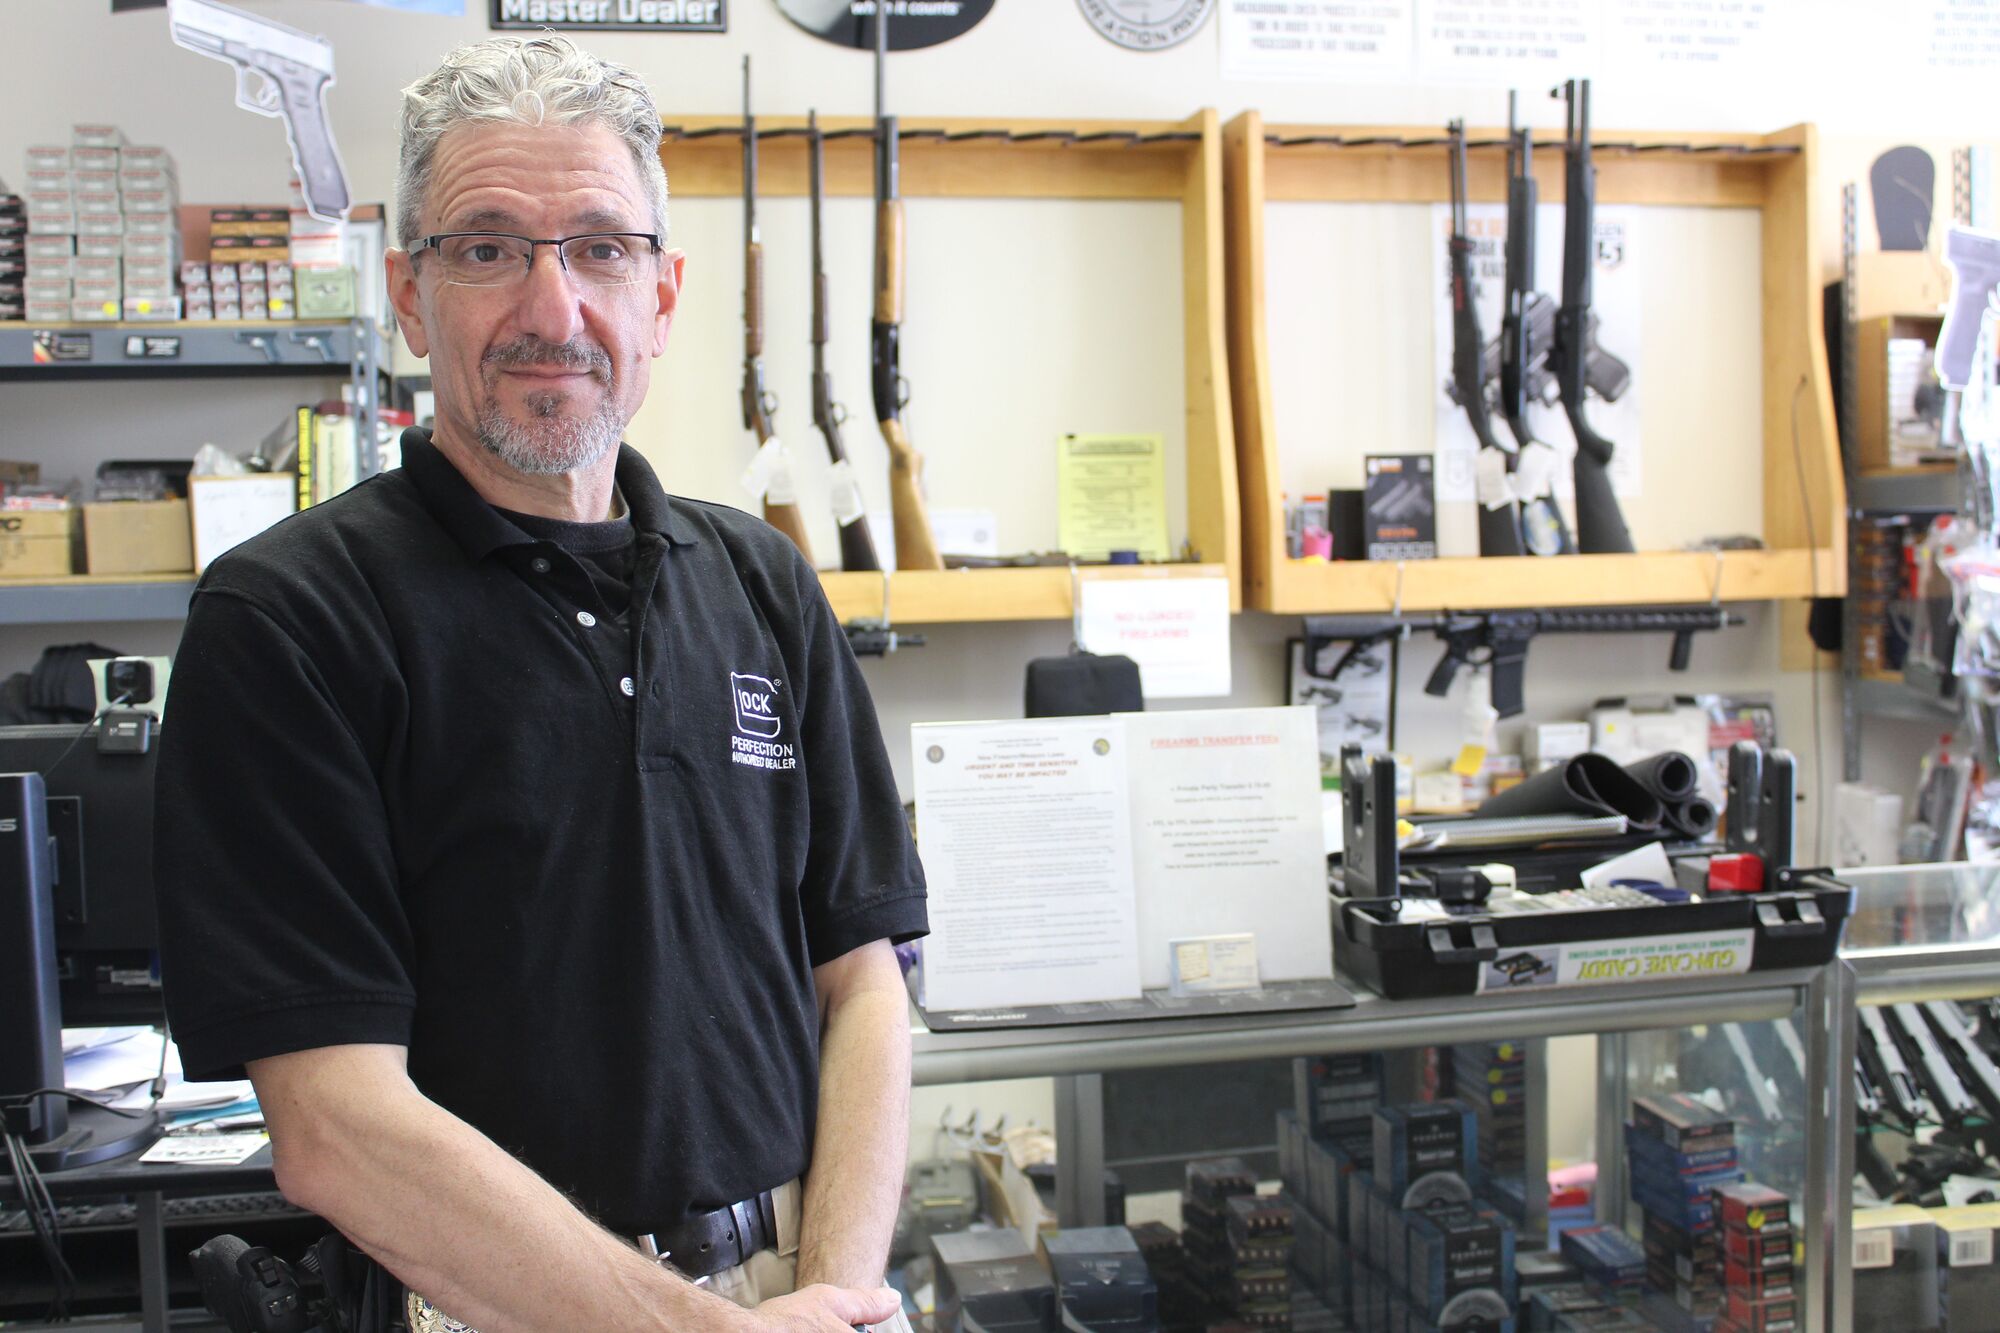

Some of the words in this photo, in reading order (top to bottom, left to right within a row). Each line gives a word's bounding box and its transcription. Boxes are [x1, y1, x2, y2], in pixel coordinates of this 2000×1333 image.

[501, 0, 610, 22] Master
[617, 0, 719, 24] Dealer
[731, 735, 793, 757] PERFECTION
[765, 758, 796, 770] DEALER
[1576, 957, 1642, 980] CADDY
